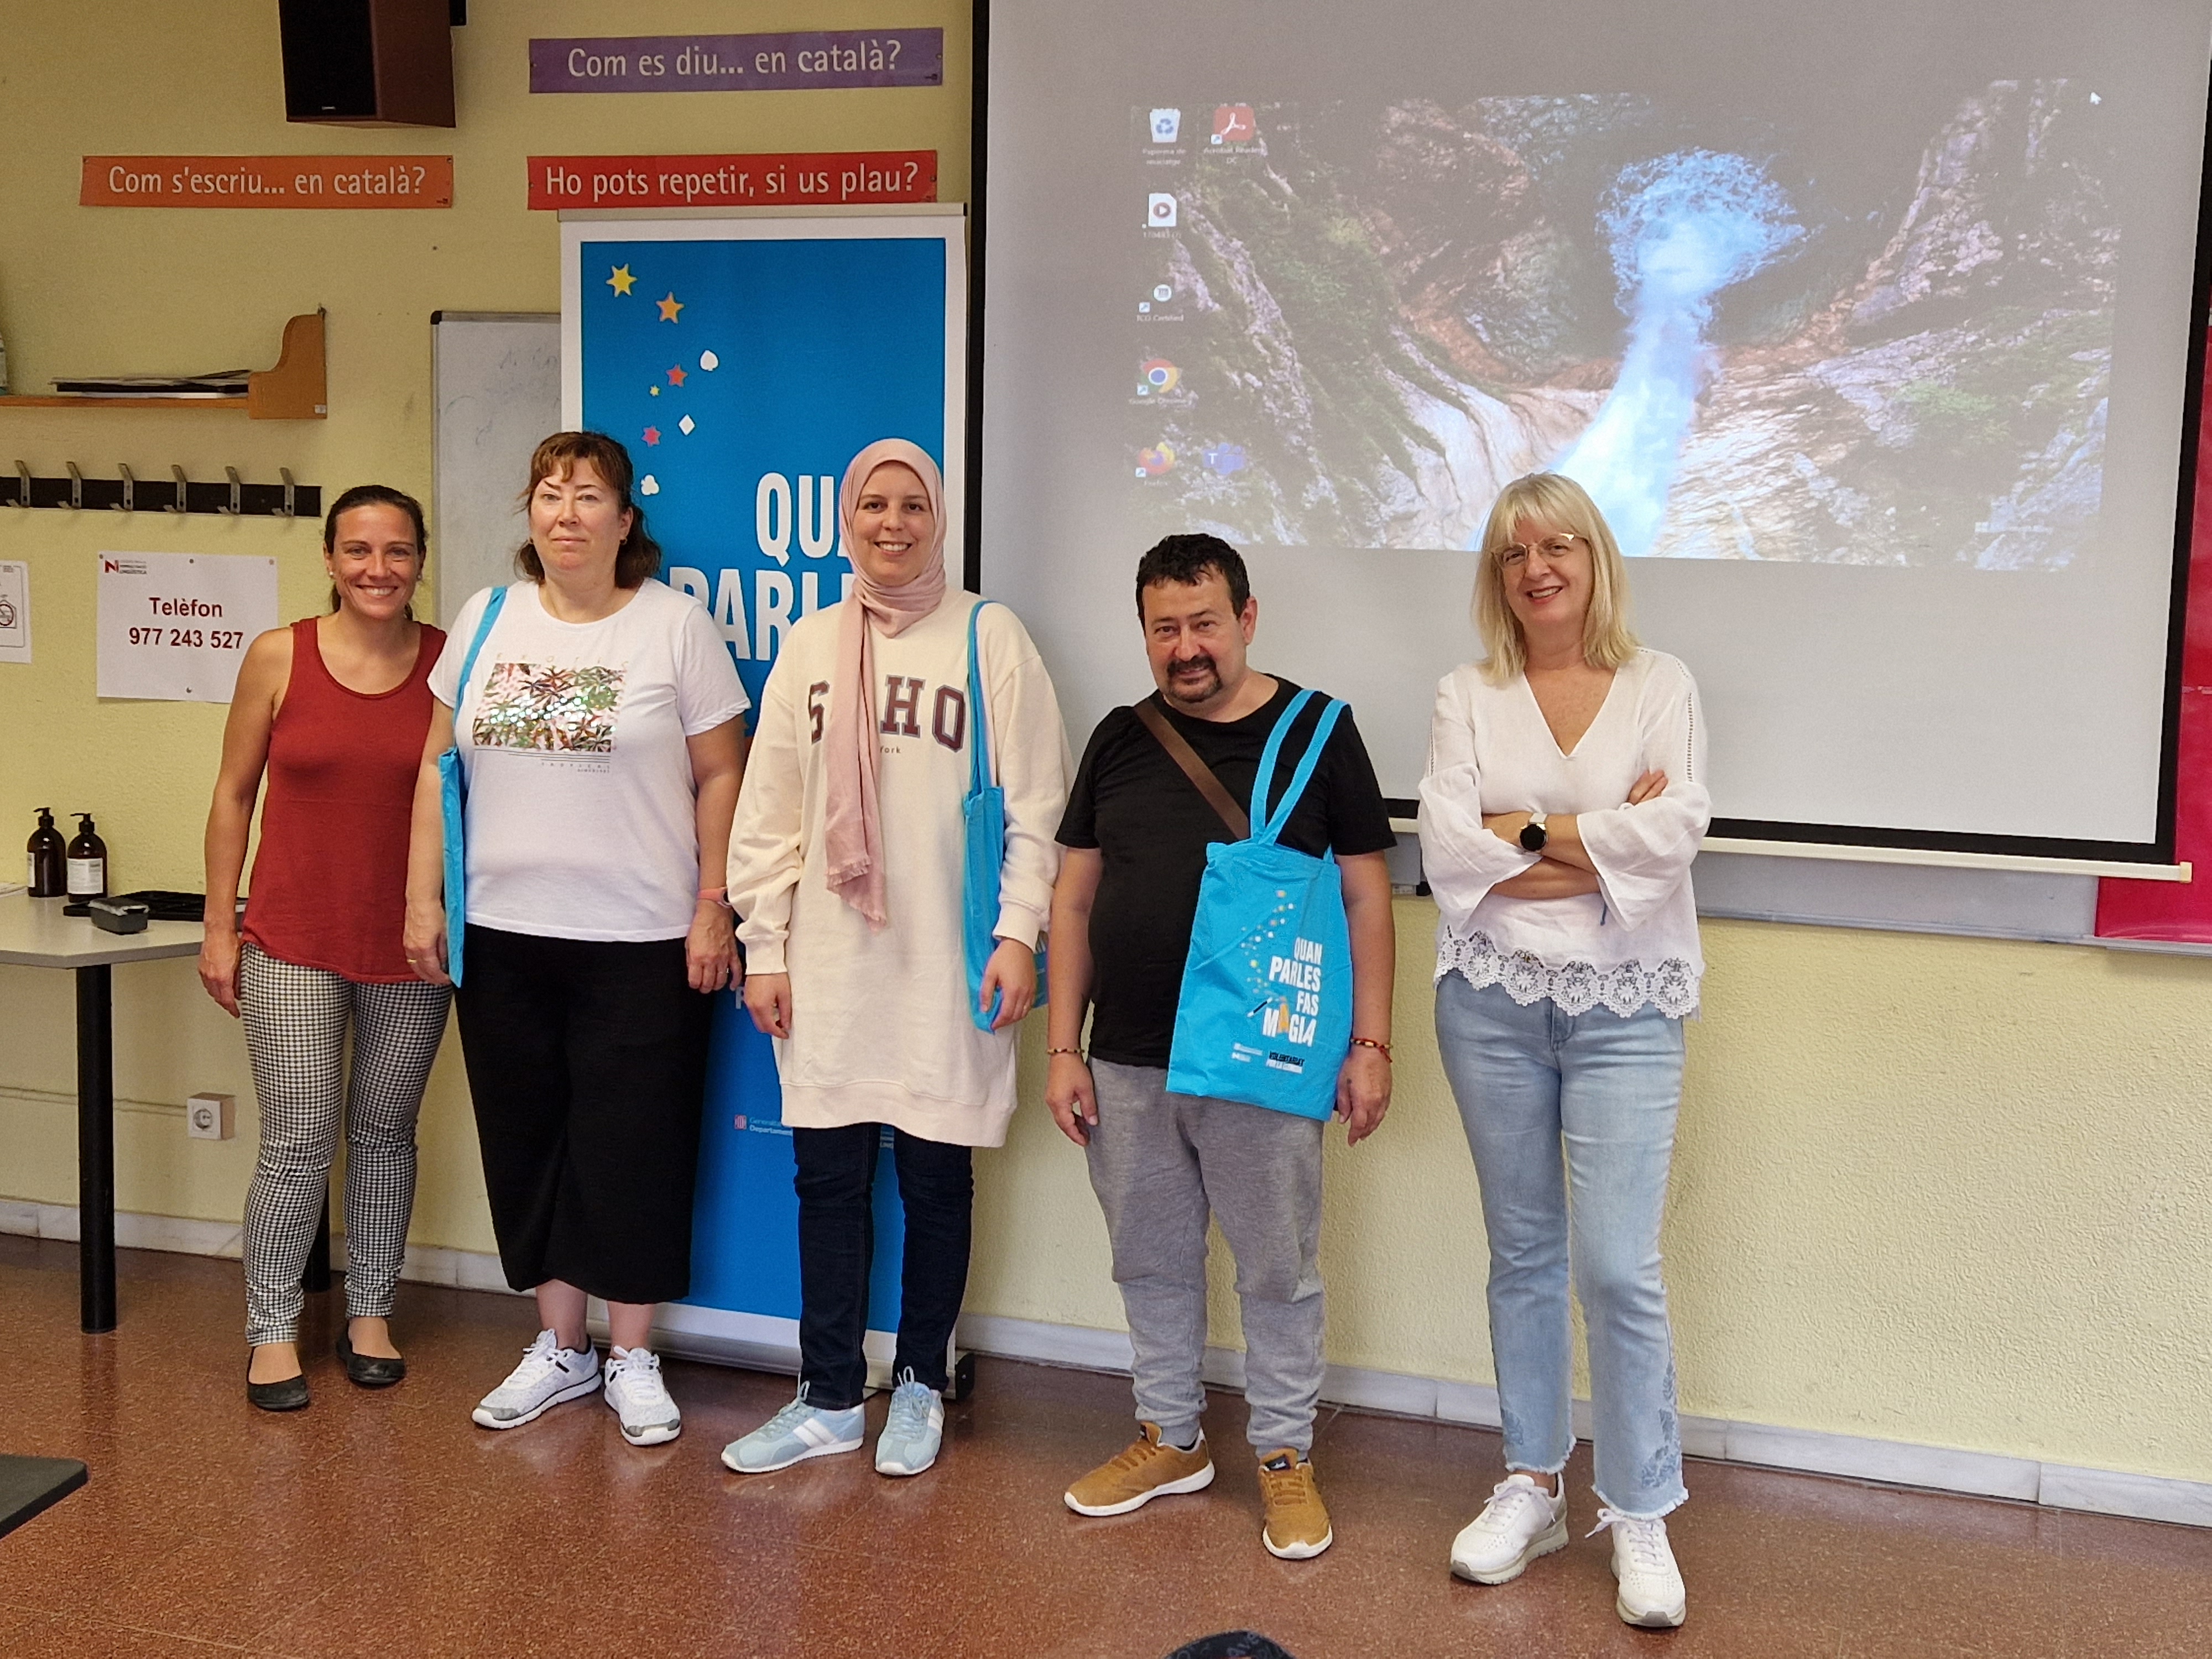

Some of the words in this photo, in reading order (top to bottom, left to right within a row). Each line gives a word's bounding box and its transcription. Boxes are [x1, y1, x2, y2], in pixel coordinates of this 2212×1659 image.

[568, 48, 627, 77] Com
[639, 55, 665, 76] es
[676, 45, 743, 75] diu...
[755, 51, 786, 74] en
[797, 39, 901, 73] català?
[109, 165, 161, 193] Com
[172, 166, 285, 194] s'escriu...
[295, 174, 323, 194] en
[333, 165, 426, 194] català?
[546, 166, 582, 195] Ho
[593, 168, 649, 203] pots
[659, 164, 754, 203] repetir,
[765, 164, 785, 194] si
[799, 171, 830, 194] us
[842, 161, 919, 201] plau?
[148, 597, 223, 618] Telèfon
[129, 627, 163, 645] 977
[170, 628, 204, 648] 243
[210, 630, 243, 649] 527
[807, 674, 966, 753] SHO
[1293, 936, 1323, 966] QUAN
[1269, 955, 1322, 993] PARLES
[1296, 990, 1319, 1016] FAS
[1262, 1002, 1317, 1047] MAGIA
